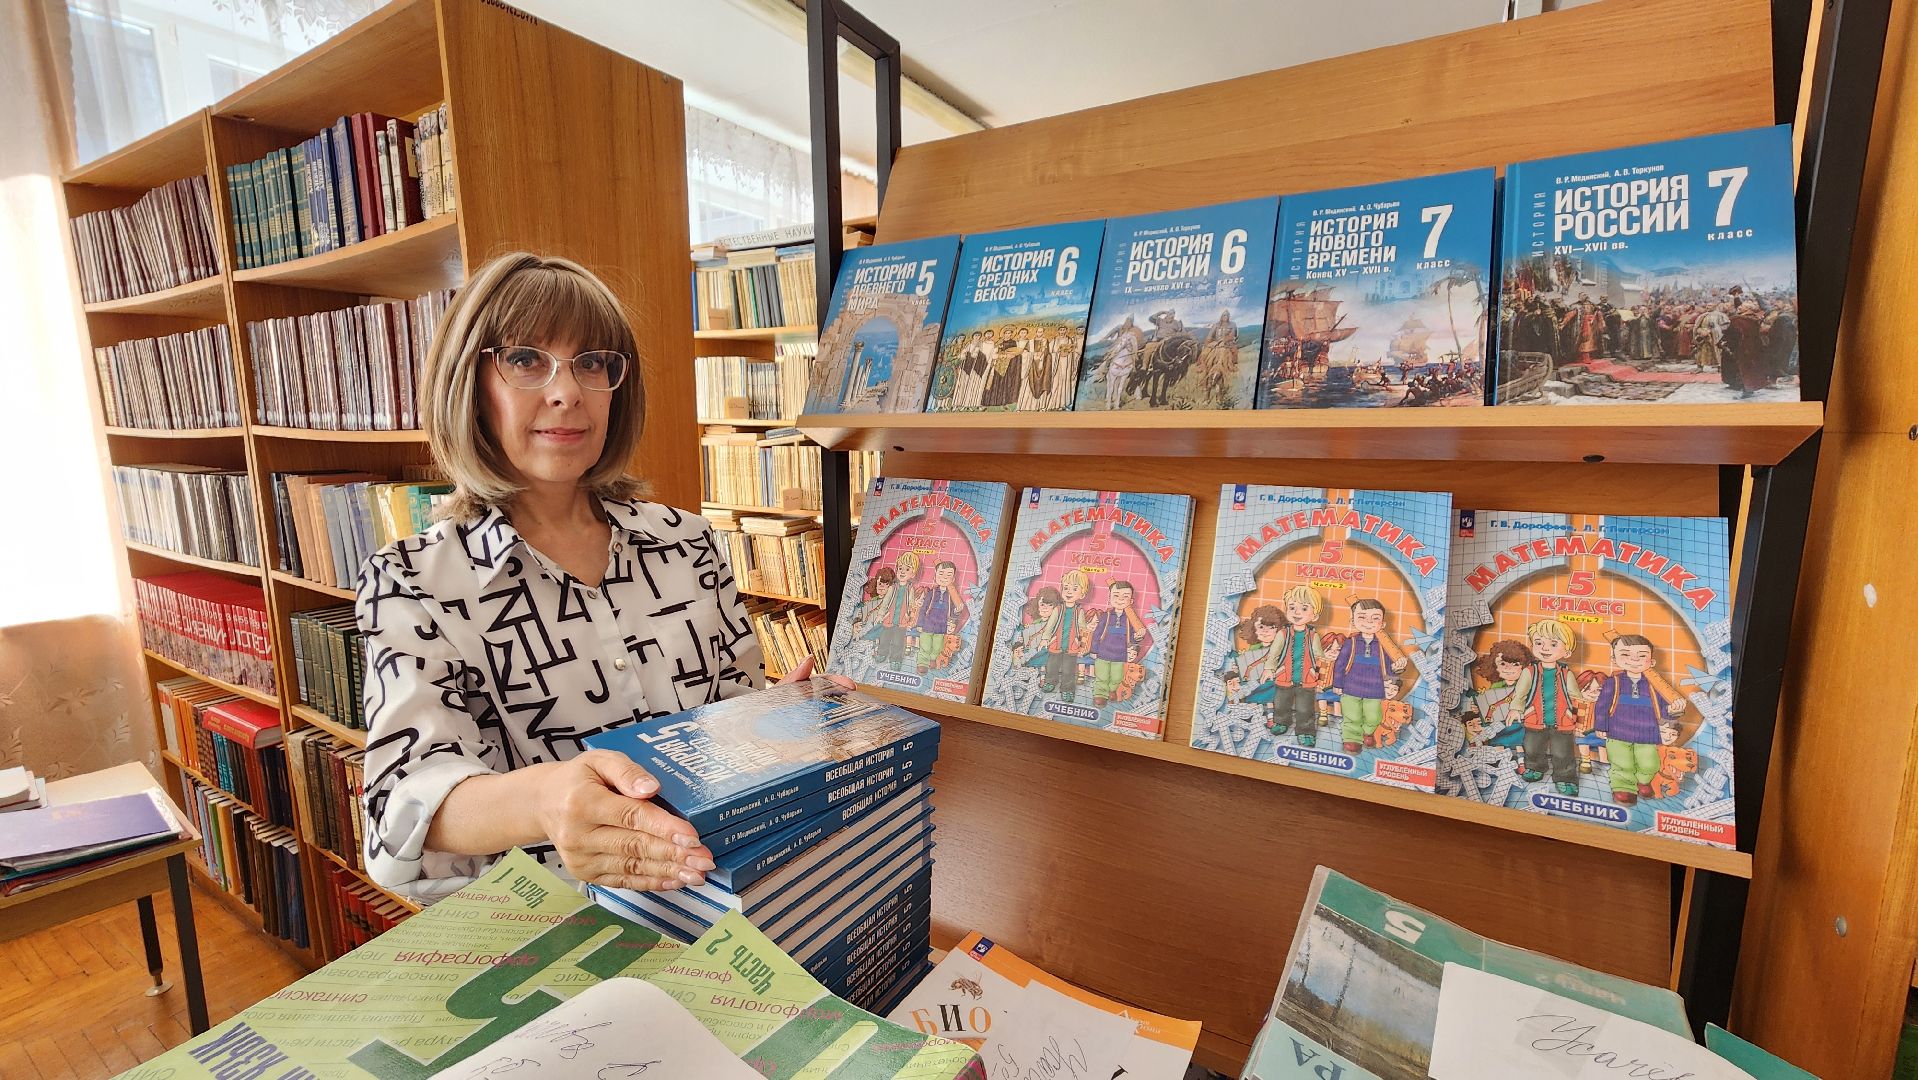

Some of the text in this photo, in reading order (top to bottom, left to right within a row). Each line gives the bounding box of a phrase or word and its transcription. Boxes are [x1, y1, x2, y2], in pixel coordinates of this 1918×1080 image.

[1555, 174, 1689, 214] ИСТОРИЯ
[1708, 166, 1749, 227] 7
[1310, 211, 1399, 236] ИСТОРИЯ
[1421, 204, 1453, 259] 7
[1532, 192, 1546, 257] ИСТОРИЯ
[1554, 199, 1689, 243] РОССИИ
[1130, 232, 1214, 261] ИСТОРИЯ
[1308, 230, 1384, 253] НОВОГО
[1611, 242, 1629, 250] вв.
[1707, 229, 1753, 241] класс
[981, 248, 1055, 273] ИСТОРИЯ
[1220, 228, 1248, 274] 6
[1289, 221, 1306, 280] ИСТОРИЯ
[1306, 246, 1397, 270] ВРЕМЕНИ
[854, 262, 917, 284] ИСТОРИЯ
[1056, 246, 1080, 287] 6
[1126, 253, 1211, 283] РОССИИ
[1306, 270, 1333, 280] Конец
[1416, 259, 1450, 270] класс
[851, 280, 906, 298] ДРЕВНЕГО
[916, 259, 937, 296] 5
[977, 269, 1040, 288] СРЕДНИХ
[1217, 277, 1244, 285] класс
[847, 296, 878, 311] МИРА
[973, 286, 1016, 303] ВЕКОВ
[871, 493, 993, 545] МАТЕМАТИКА
[1491, 520, 1497, 528] Г.
[905, 536, 948, 549] КЛАСС
[1028, 506, 1175, 563] МАТЕМАТИКА
[1089, 533, 1107, 551] 5
[1234, 507, 1439, 577] МАТЕМАТИКА
[1071, 552, 1121, 567] КЛАСС
[1320, 540, 1344, 564] 5
[1296, 563, 1365, 581] КЛАСС
[1464, 536, 1718, 611] МАТЕМАТИКА
[1567, 571, 1595, 596] 5
[1540, 597, 1625, 615] КЛАСС
[1563, 615, 1592, 623] Часть
[880, 673, 919, 686] УЧЕБНИК
[1049, 703, 1095, 719] УЧЕБНИК
[636, 721, 701, 743] 5
[653, 738, 737, 784] ИСТОРИЯ
[825, 757, 864, 782] ВСЕОБЩАЯ
[865, 747, 895, 768] ИСТОРИЯ
[903, 741, 914, 751] 5
[1282, 749, 1348, 768] УЧЕБНИК
[828, 776, 865, 803] ВСЕОБЩАЯ
[866, 766, 894, 789] ИСТОРИЯ
[902, 760, 913, 770] 5
[842, 795, 873, 821] ВСЕОБЩАЯ
[874, 780, 897, 802] ИСТОРИЯ
[903, 773, 912, 782] 5
[1539, 795, 1620, 820] УЧЕБНИК
[1661, 824, 1700, 837] УРОВЕНЬ
[449, 890, 511, 905] фонетик
[491, 867, 549, 909] Часть 1
[846, 883, 913, 945] ВСЕОБЩАЯ ИСТОРИЯ 5
[846, 902, 912, 965] ВСЕОБЩАЯ ИСТОРИЯ 5
[1383, 910, 1426, 944] 5
[705, 929, 776, 996] Часть 2
[846, 922, 911, 987] ВСЕОБЩАЯ ИСТОРИЯ 5
[664, 965, 733, 985] фонетик
[188, 1022, 289, 1080] ЯЗЫК
